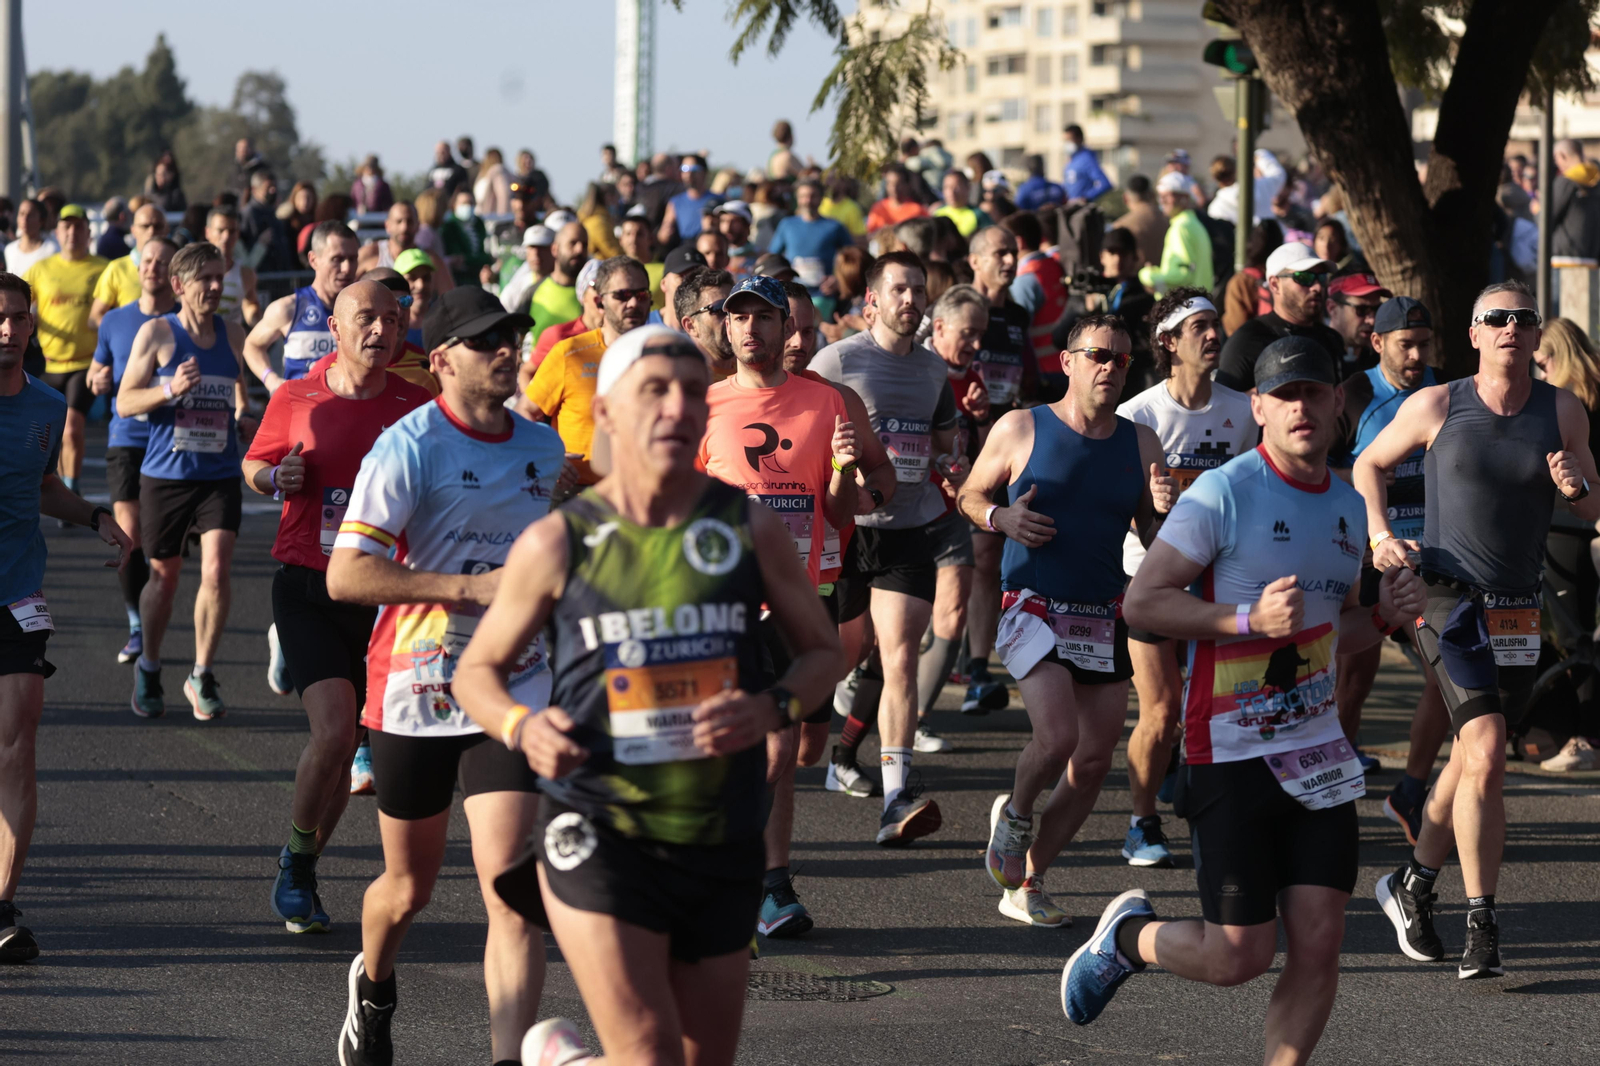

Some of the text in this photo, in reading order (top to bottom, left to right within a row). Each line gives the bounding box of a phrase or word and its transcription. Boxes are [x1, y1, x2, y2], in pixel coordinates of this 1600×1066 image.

[189, 430, 217, 438] RICHARD
[901, 441, 920, 453] 7111
[1183, 457, 1221, 467] ZURICH
[764, 498, 807, 508] ZURICH
[1071, 603, 1108, 615] ZURICH
[598, 603, 746, 643] BELONG
[1500, 619, 1518, 630] 4134
[1068, 625, 1092, 637] 6299
[650, 638, 725, 660] ZURICH
[1065, 642, 1094, 653] LUIS FM
[1234, 680, 1259, 695] LOS
[1299, 749, 1328, 769] 6301
[1300, 767, 1344, 791] WARRIOR
